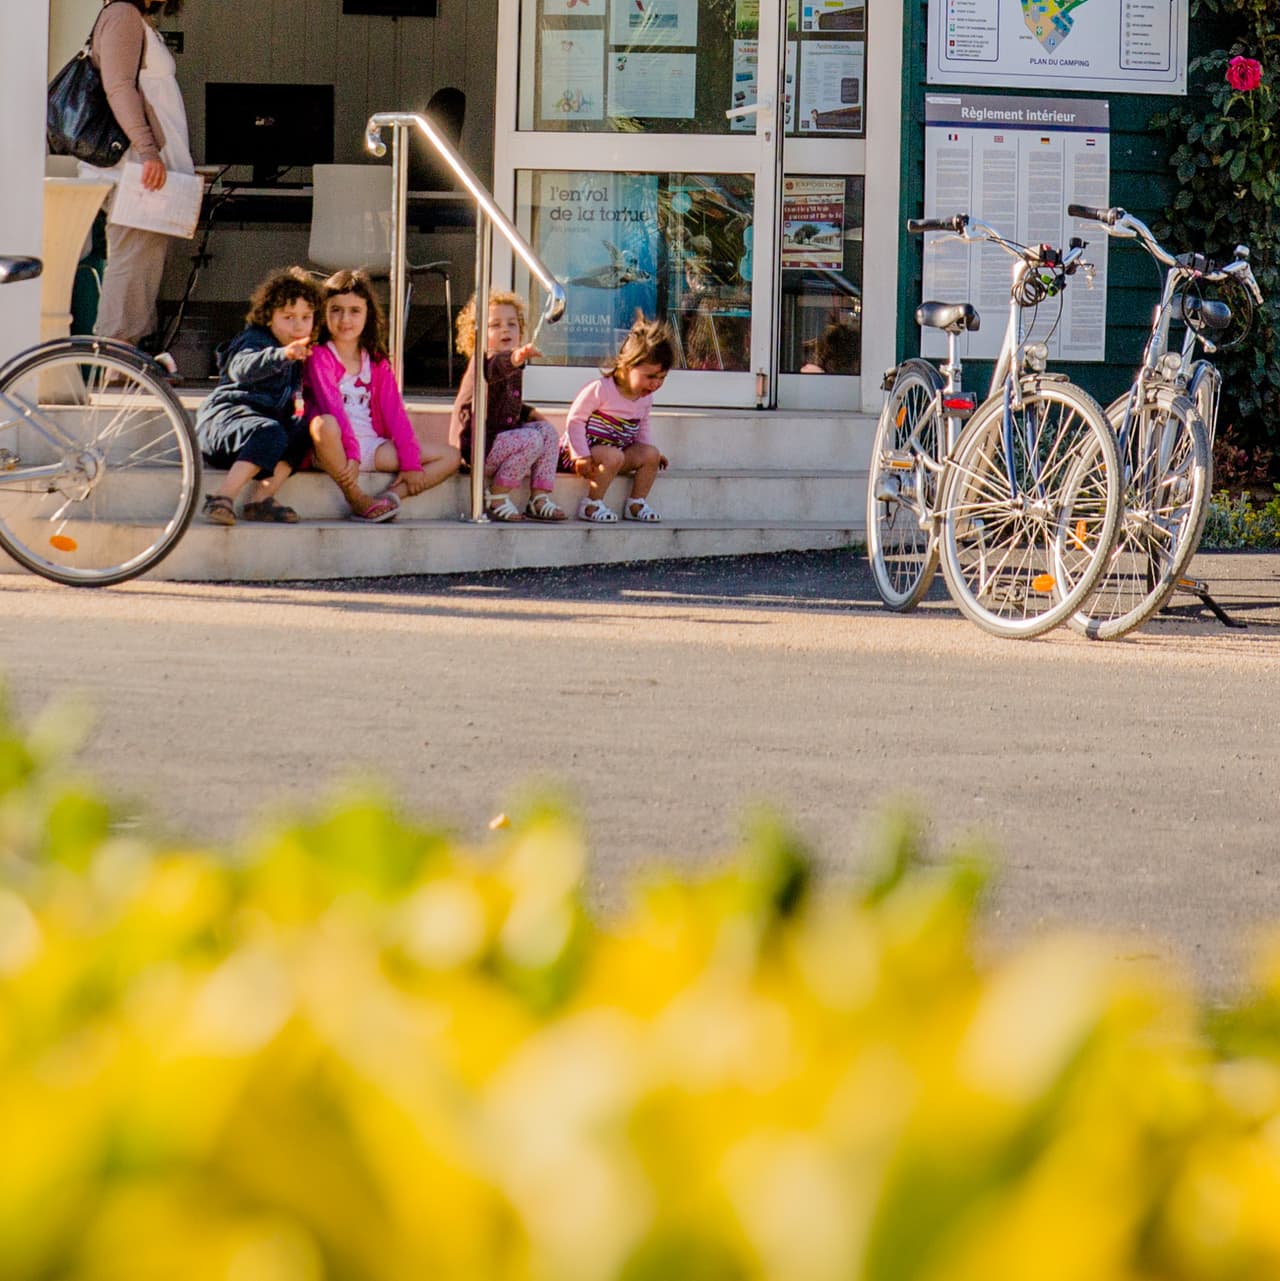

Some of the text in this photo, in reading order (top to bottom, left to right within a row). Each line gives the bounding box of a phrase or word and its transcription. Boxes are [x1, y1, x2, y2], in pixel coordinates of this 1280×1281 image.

[1048, 58, 1059, 66] DU
[1060, 59, 1090, 67] CAMPING
[961, 106, 1077, 123] Règlement intérieur
[550, 186, 609, 202] l'envol
[550, 206, 650, 222] de la tortue
